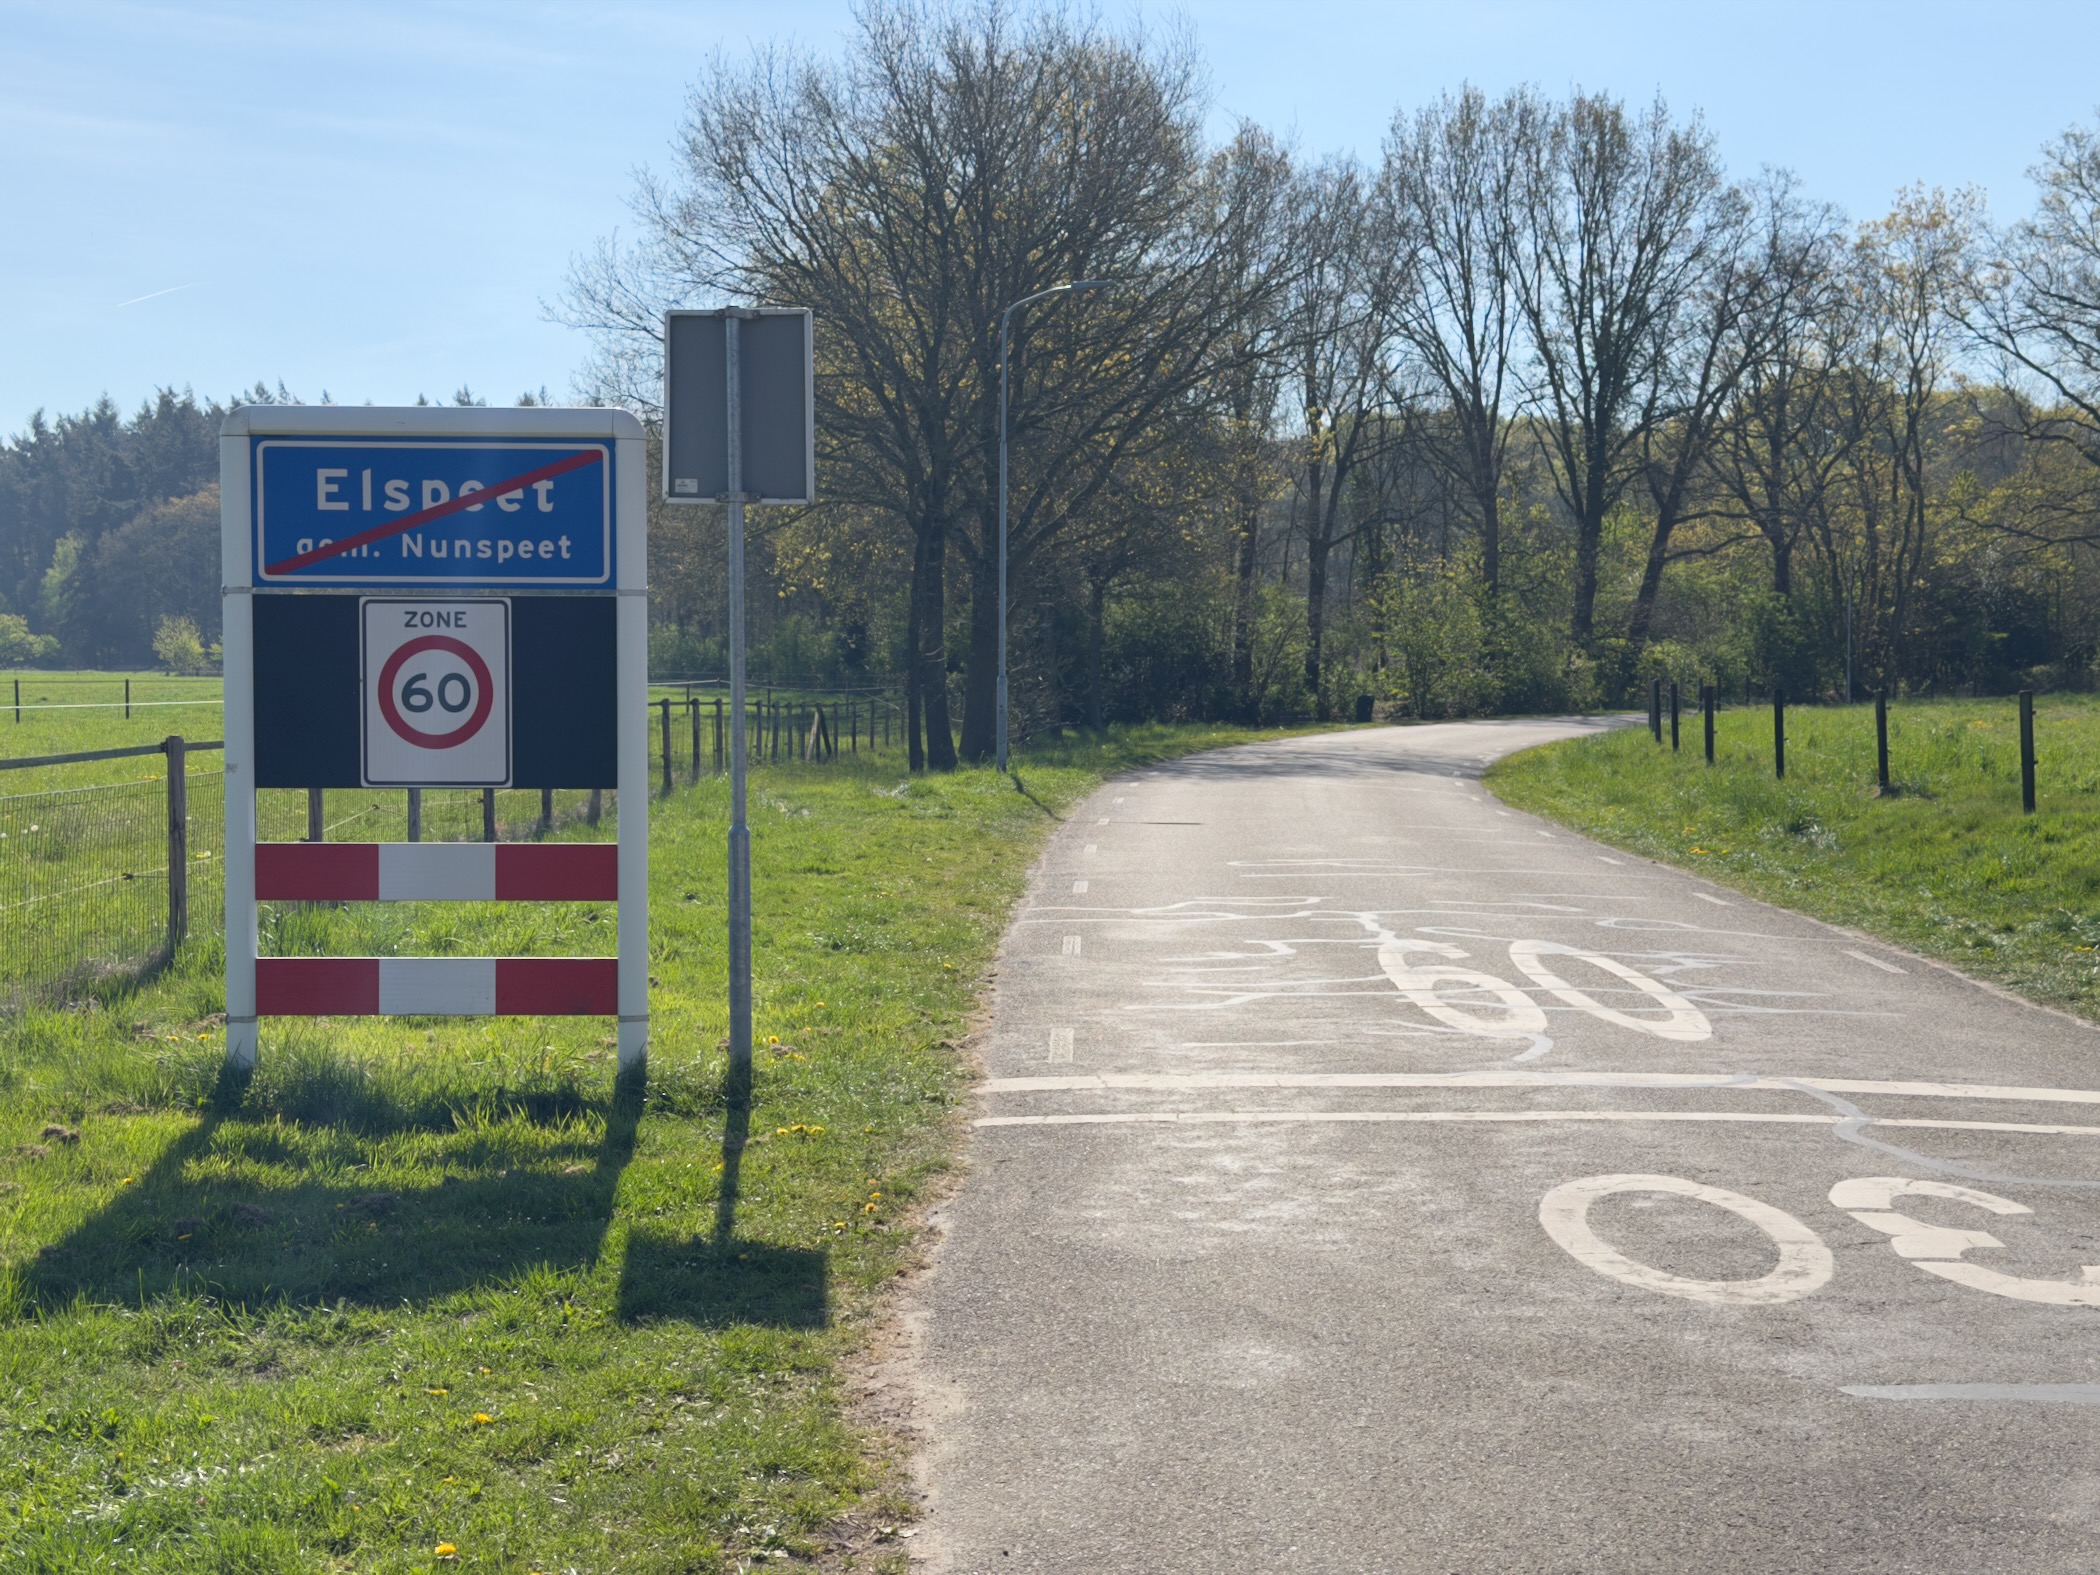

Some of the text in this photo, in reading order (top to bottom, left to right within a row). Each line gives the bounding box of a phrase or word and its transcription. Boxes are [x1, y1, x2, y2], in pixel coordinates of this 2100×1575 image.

[316, 468, 555, 513] Elspeet
[402, 533, 571, 564] Nunspeet
[404, 611, 467, 628] ZONE
[401, 672, 471, 714] 60
[1378, 939, 1712, 1041] 60
